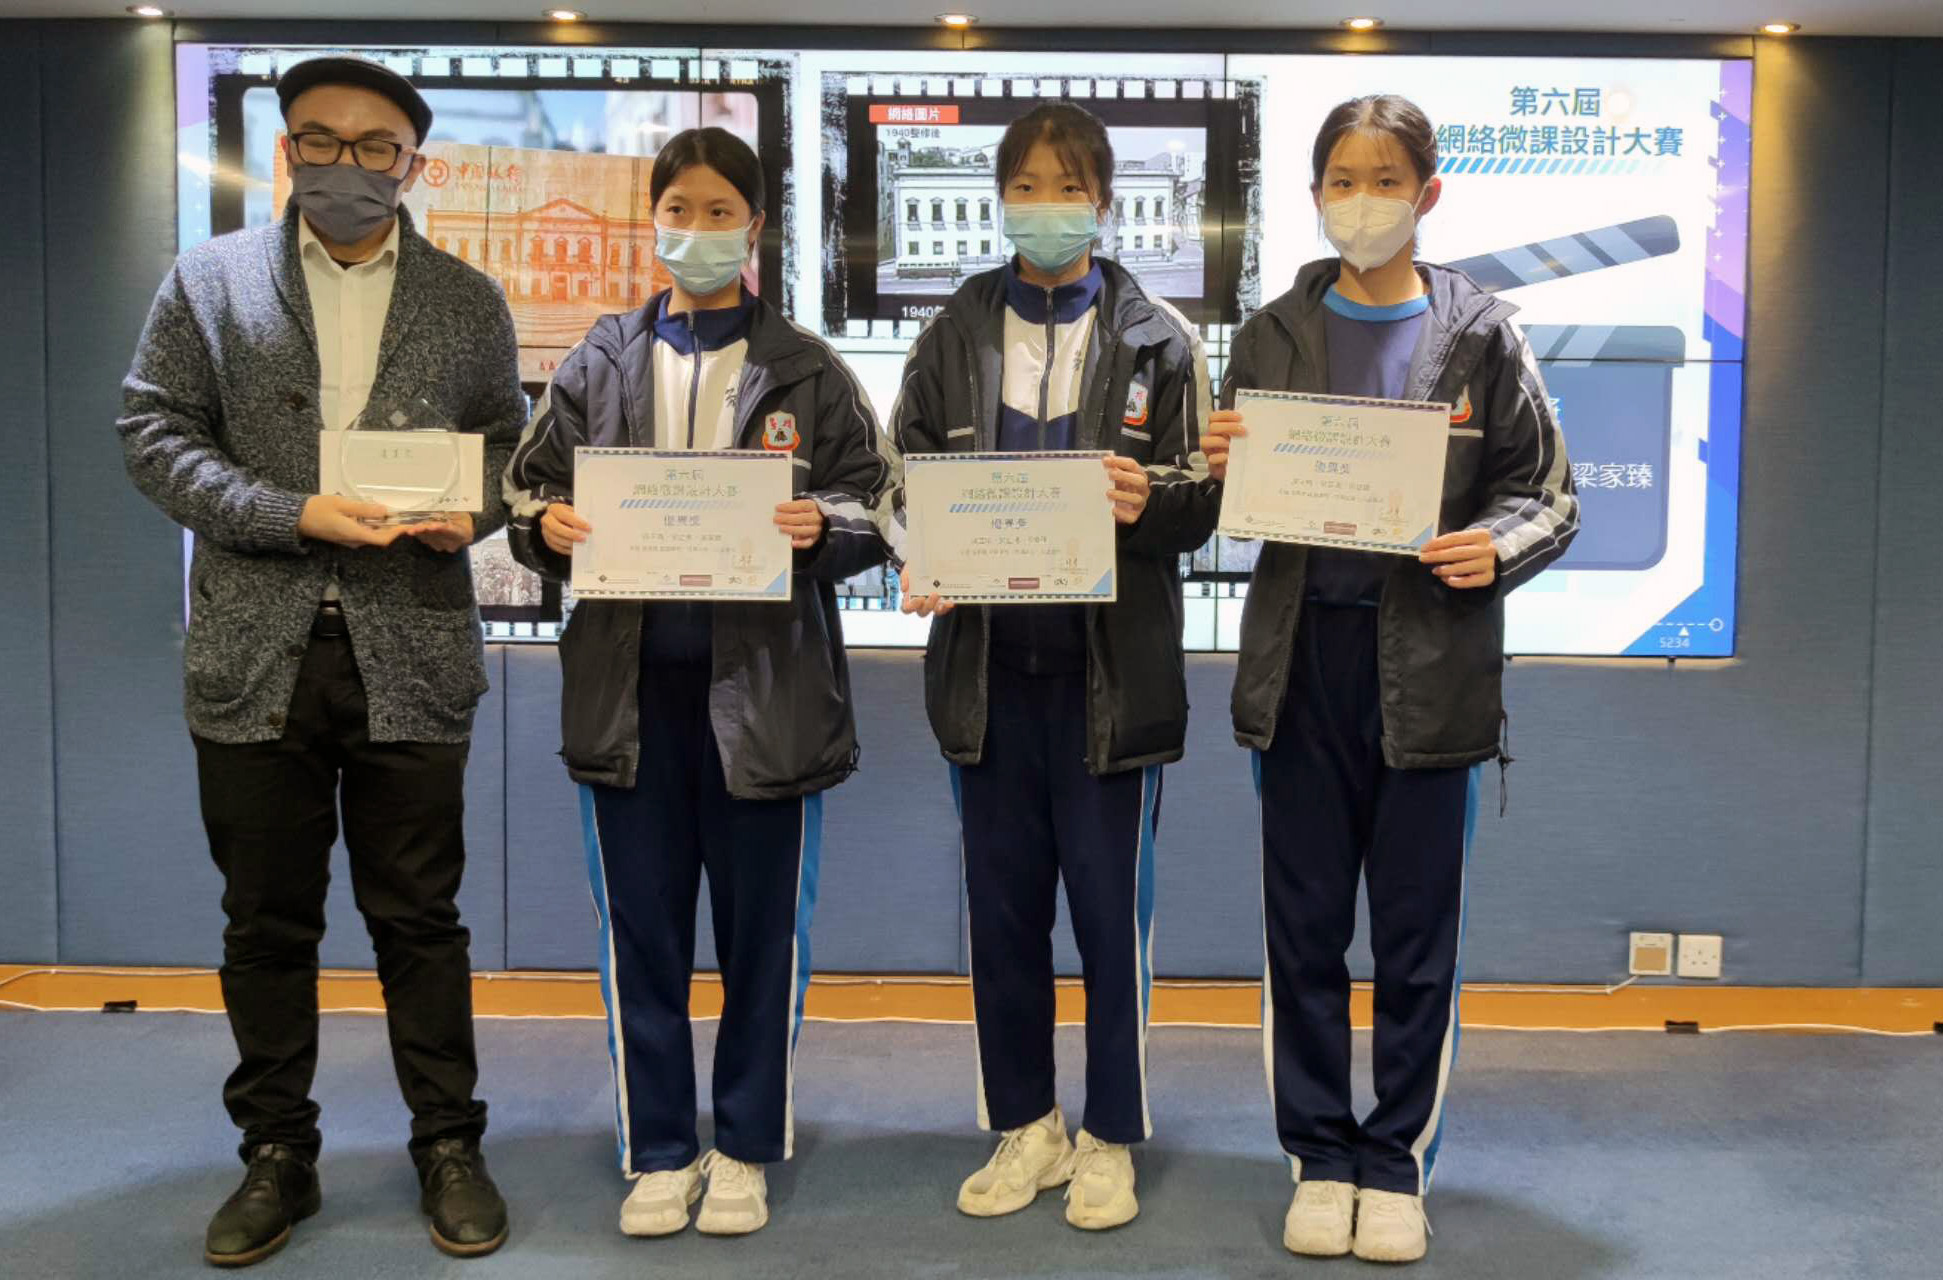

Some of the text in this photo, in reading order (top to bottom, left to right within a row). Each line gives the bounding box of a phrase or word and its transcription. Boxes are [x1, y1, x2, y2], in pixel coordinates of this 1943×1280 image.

[1509, 86, 1601, 118] 第六屆
[1437, 124, 1683, 157] 網絡微課設計大賽
[1572, 462, 1653, 489] 梁家臻
